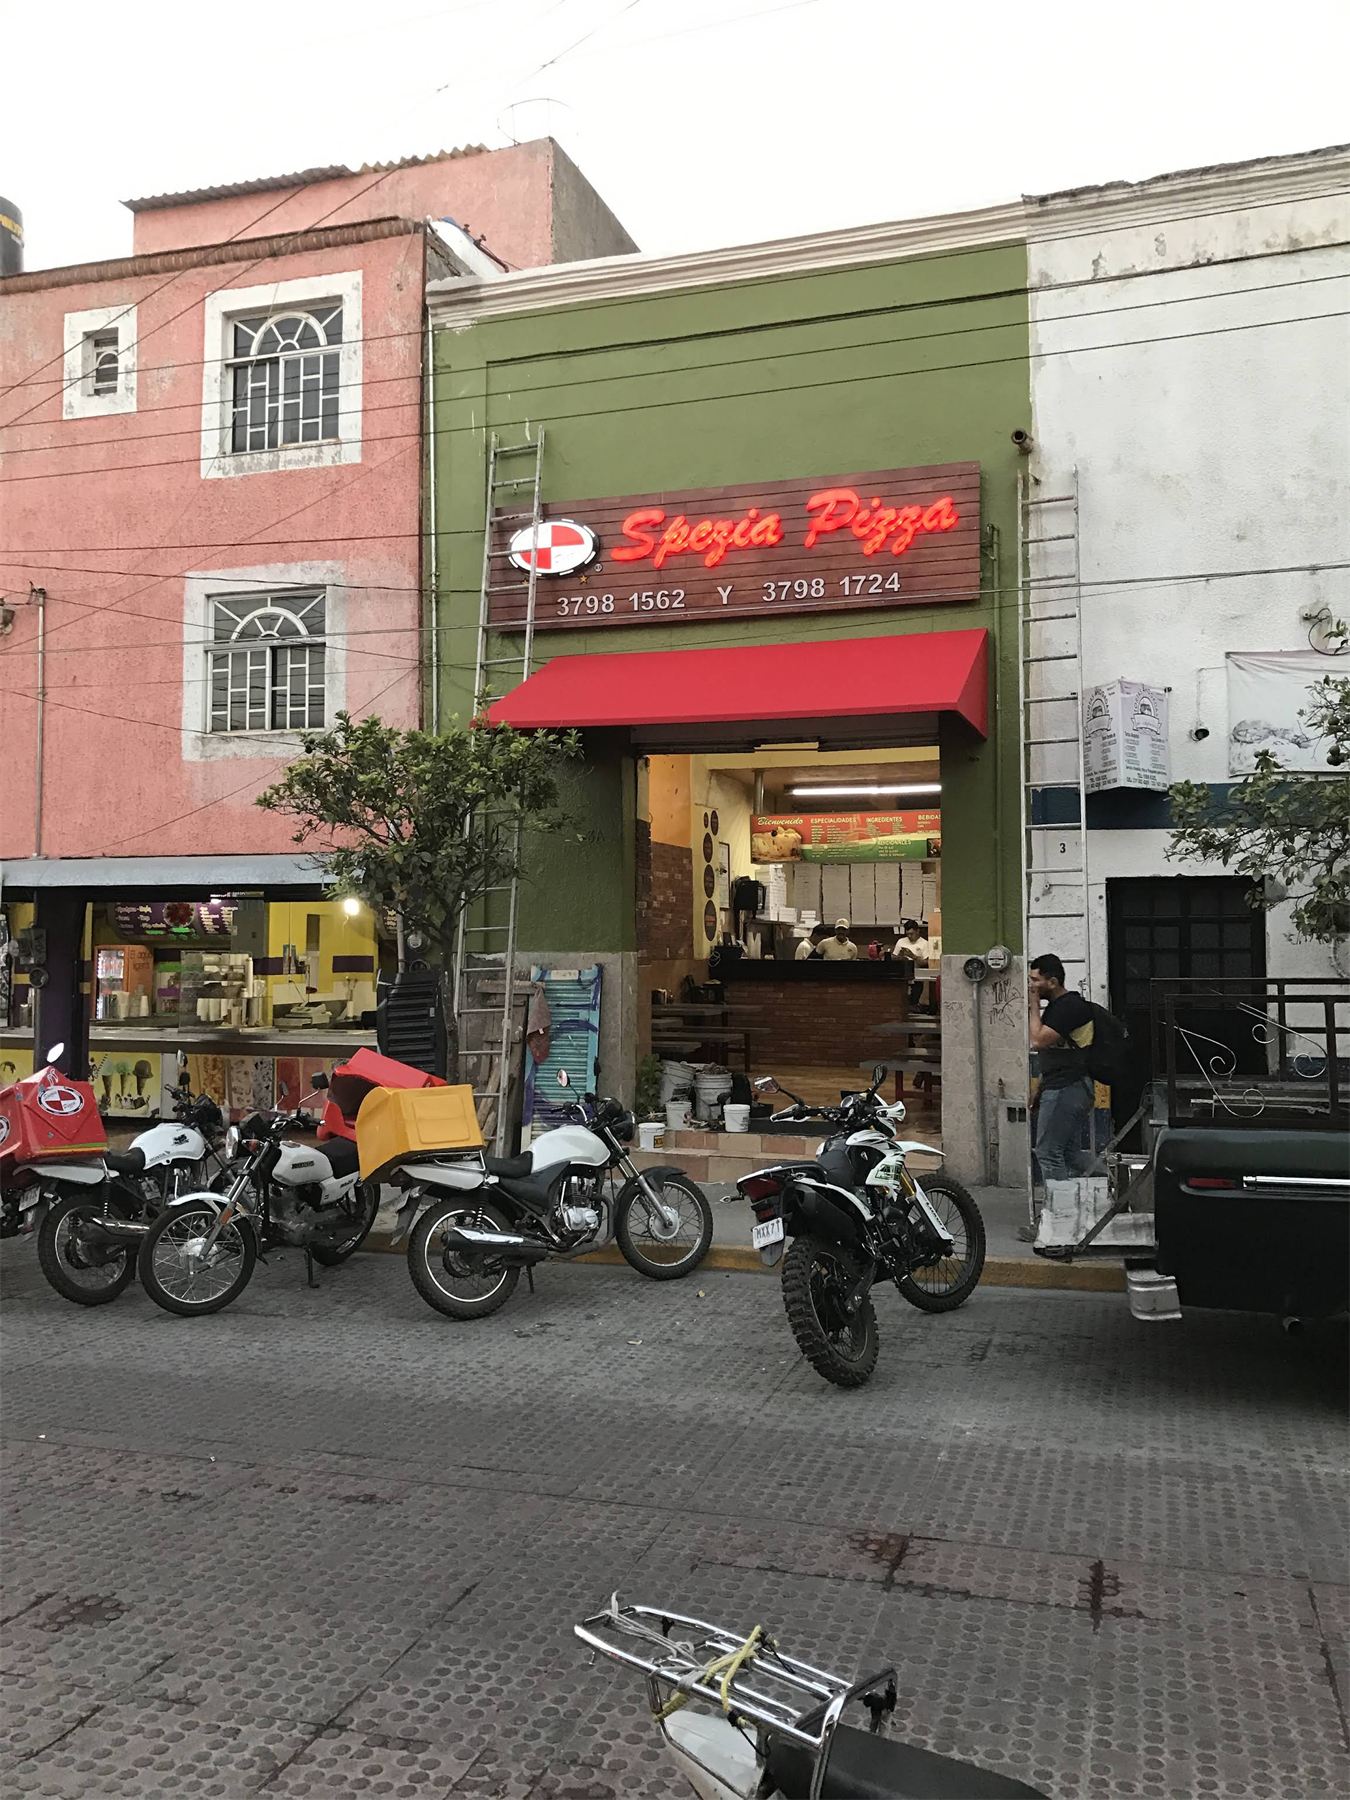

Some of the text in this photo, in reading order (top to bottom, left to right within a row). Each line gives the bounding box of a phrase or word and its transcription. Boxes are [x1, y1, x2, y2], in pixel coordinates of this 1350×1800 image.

[610, 488, 959, 569] Spezia Pizza
[556, 571, 901, 617] 3798 1562 Y 3798 1724
[757, 816, 804, 826] Bienvenido
[810, 816, 857, 824] ESPECIALIDADES
[1059, 842, 1066, 854] 3
